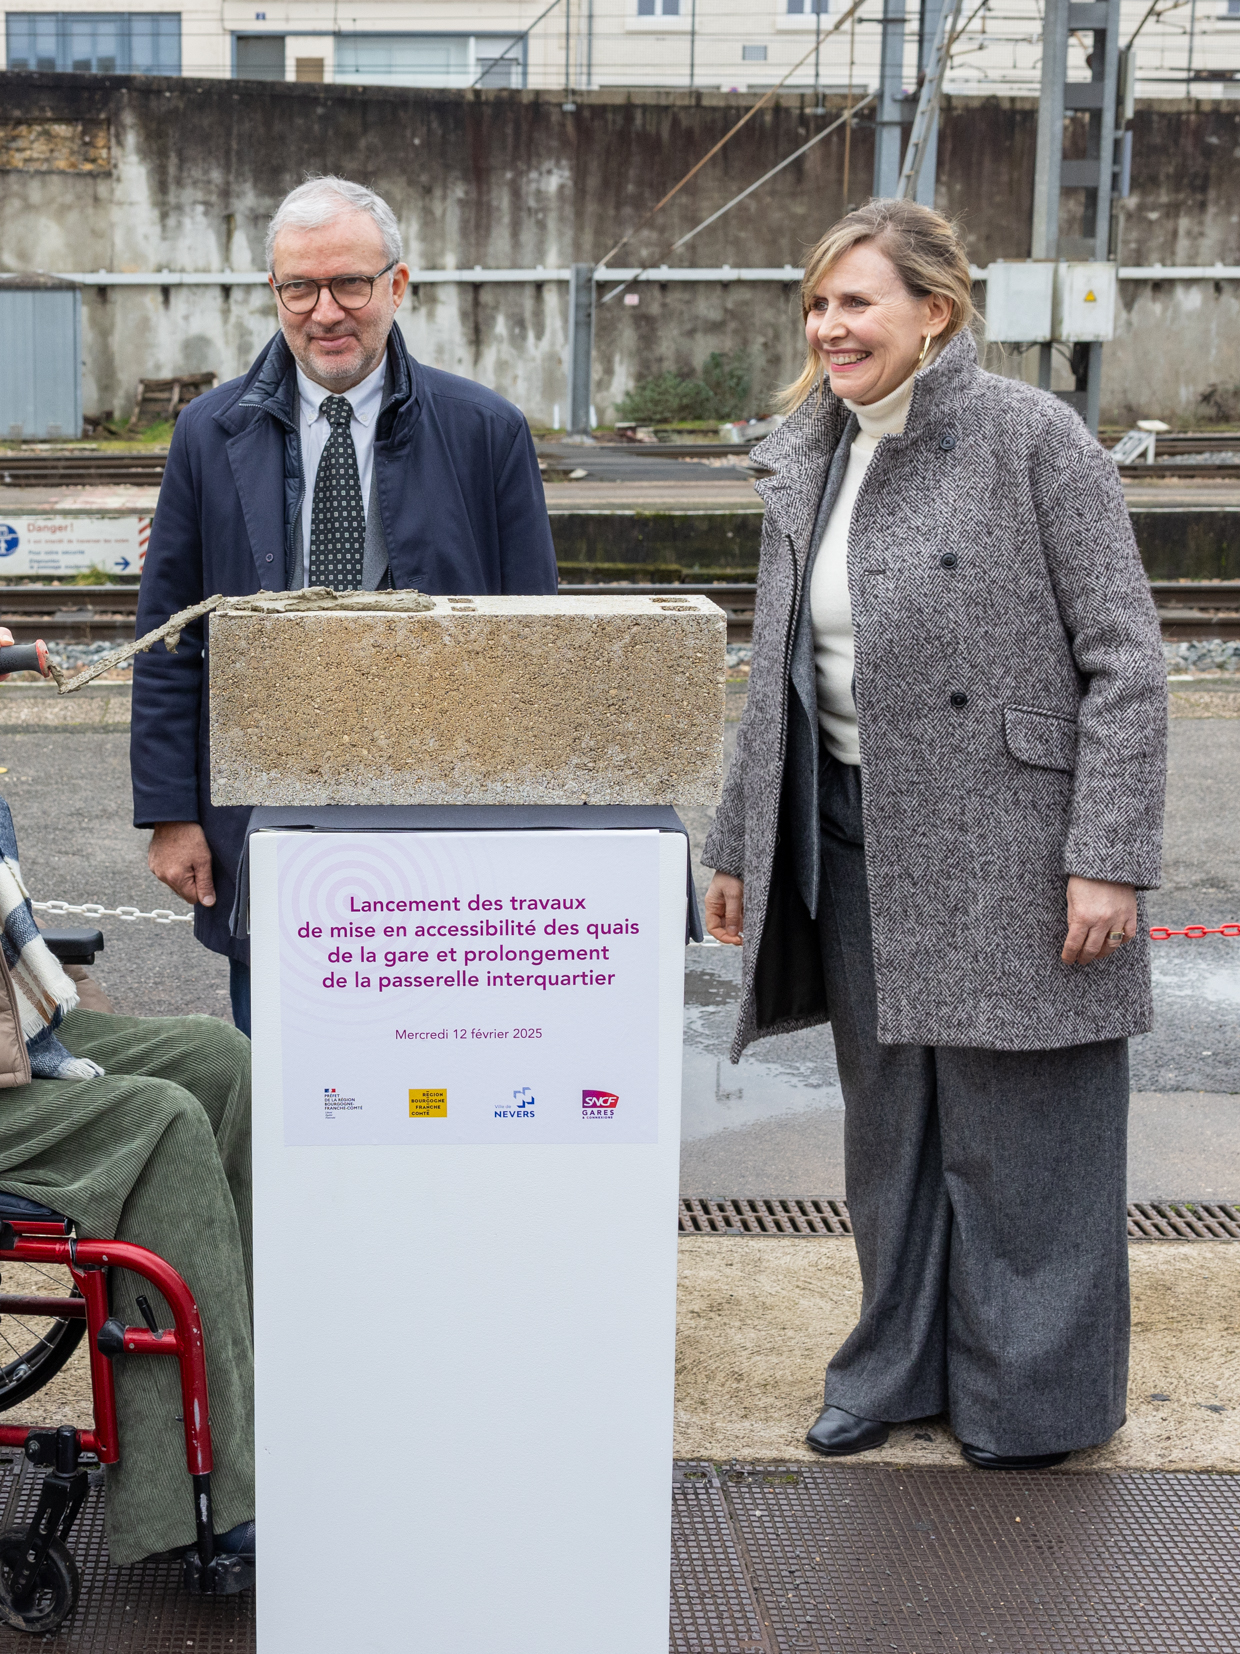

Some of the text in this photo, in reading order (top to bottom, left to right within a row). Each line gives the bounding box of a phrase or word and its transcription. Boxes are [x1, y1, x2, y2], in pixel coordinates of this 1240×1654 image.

[350, 894, 587, 913] Lancement des travaux
[297, 918, 640, 940] de mise en accessibilité des quais
[327, 944, 610, 967] de la gare et prolongement
[322, 969, 616, 992] de la passerelle interquartier
[395, 1027, 543, 1040] Mercredi 12 février 2025
[583, 1096, 617, 1107] SNCF
[494, 1110, 535, 1118] NEVERS
